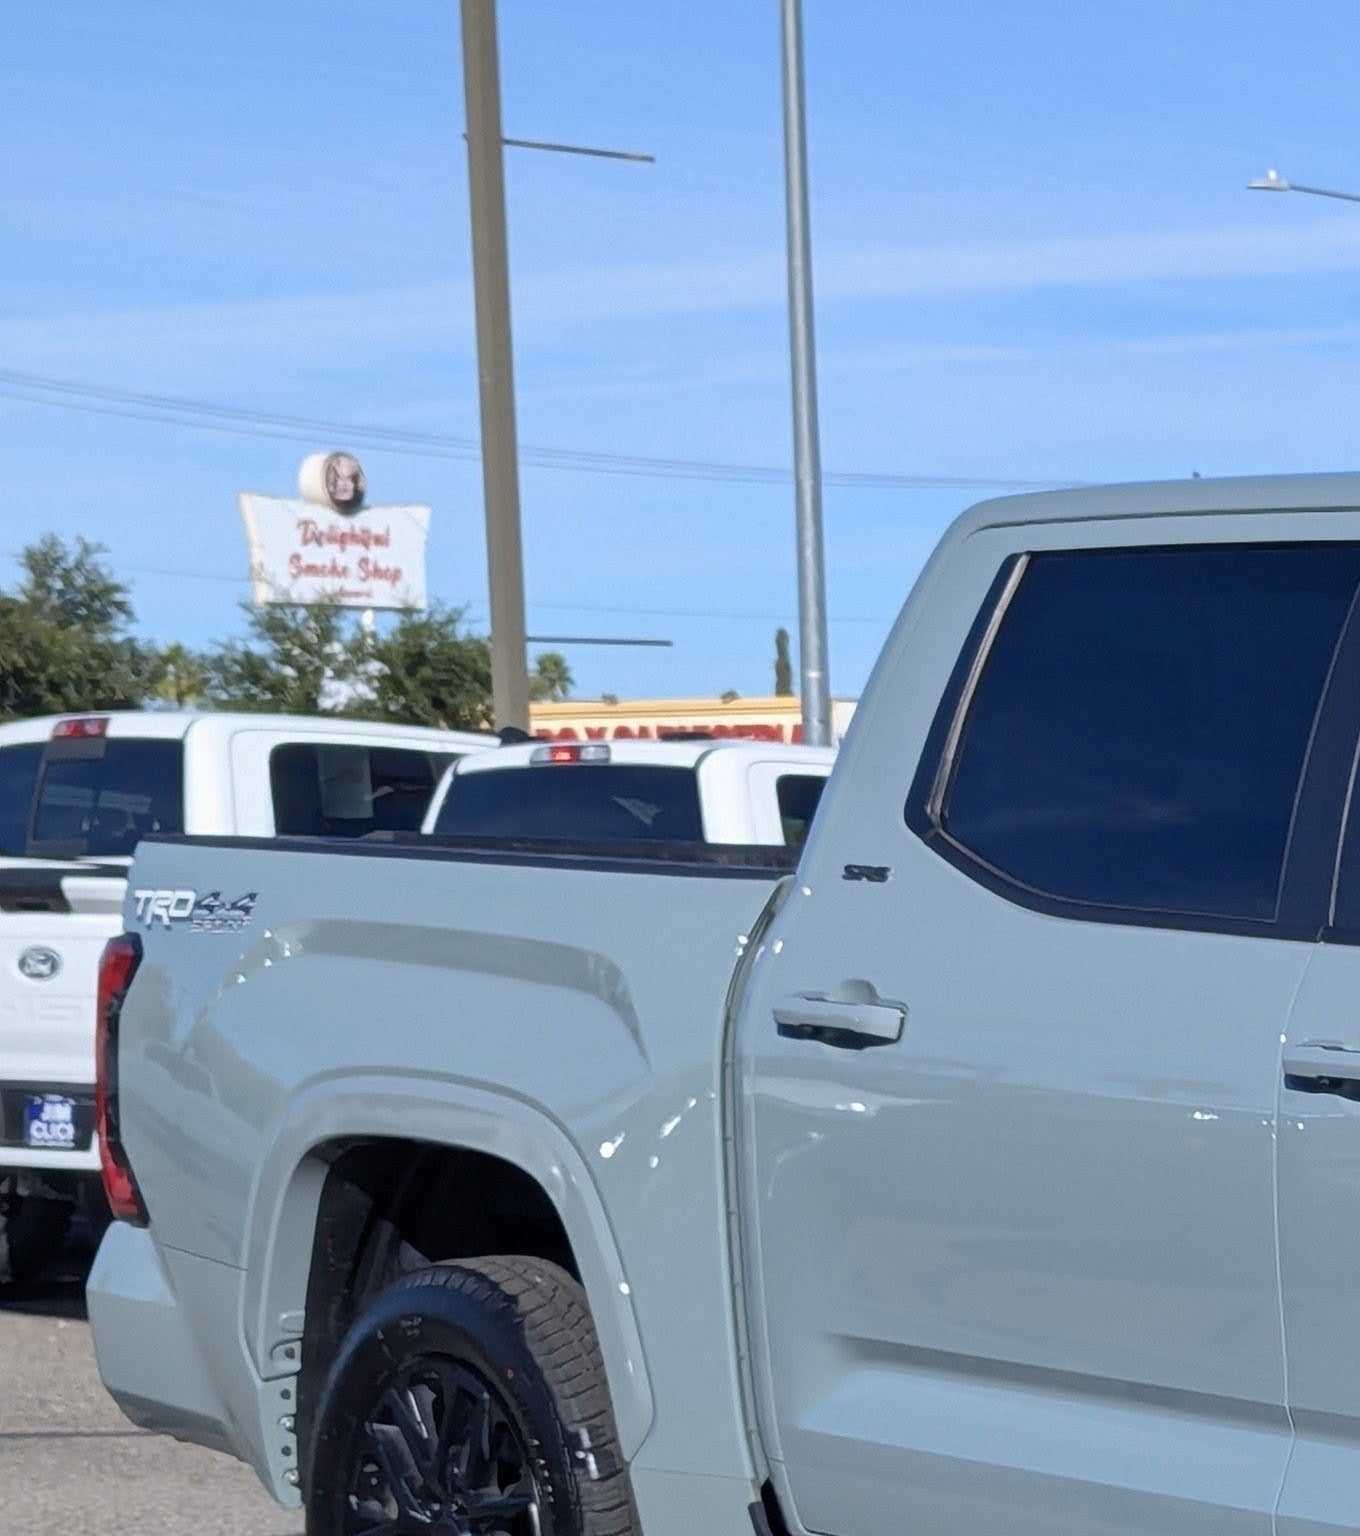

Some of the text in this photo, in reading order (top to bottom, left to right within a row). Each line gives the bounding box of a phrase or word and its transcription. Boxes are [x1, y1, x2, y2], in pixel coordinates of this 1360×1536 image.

[288, 553, 402, 588] Smoke Shop
[134, 889, 196, 930] TRD
